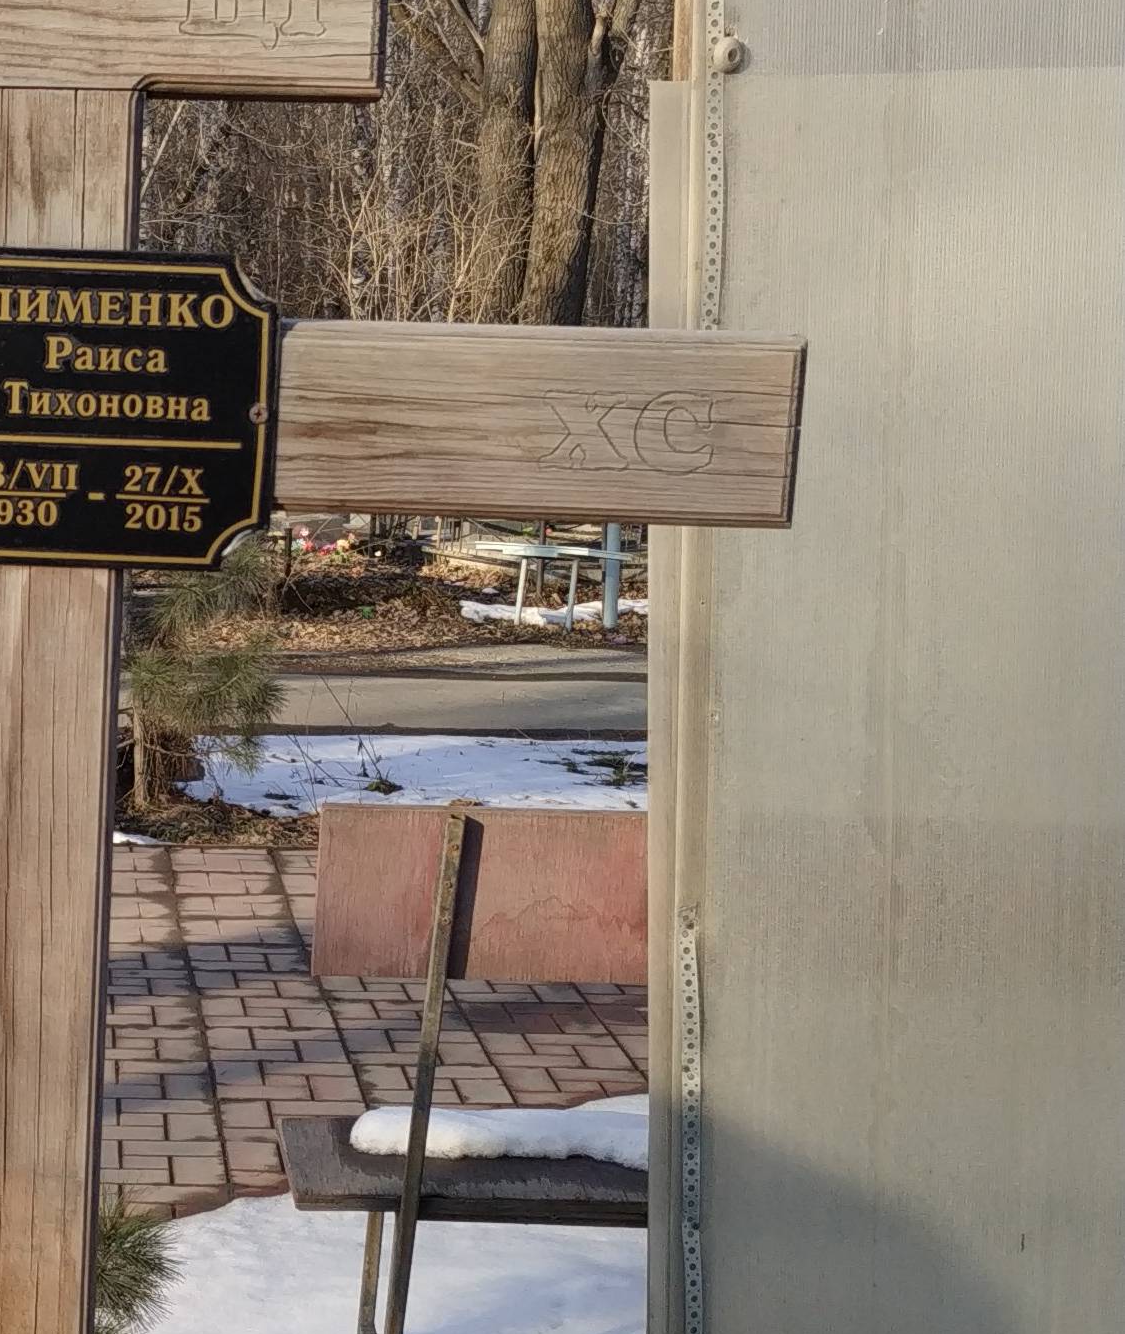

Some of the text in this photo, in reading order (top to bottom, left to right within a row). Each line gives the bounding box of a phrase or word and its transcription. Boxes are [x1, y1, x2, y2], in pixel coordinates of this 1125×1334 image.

[45, 334, 168, 374] Раиса
[3, 380, 211, 422] Тихоновна
[124, 465, 205, 496] 27/X
[124, 503, 203, 533] 2015
